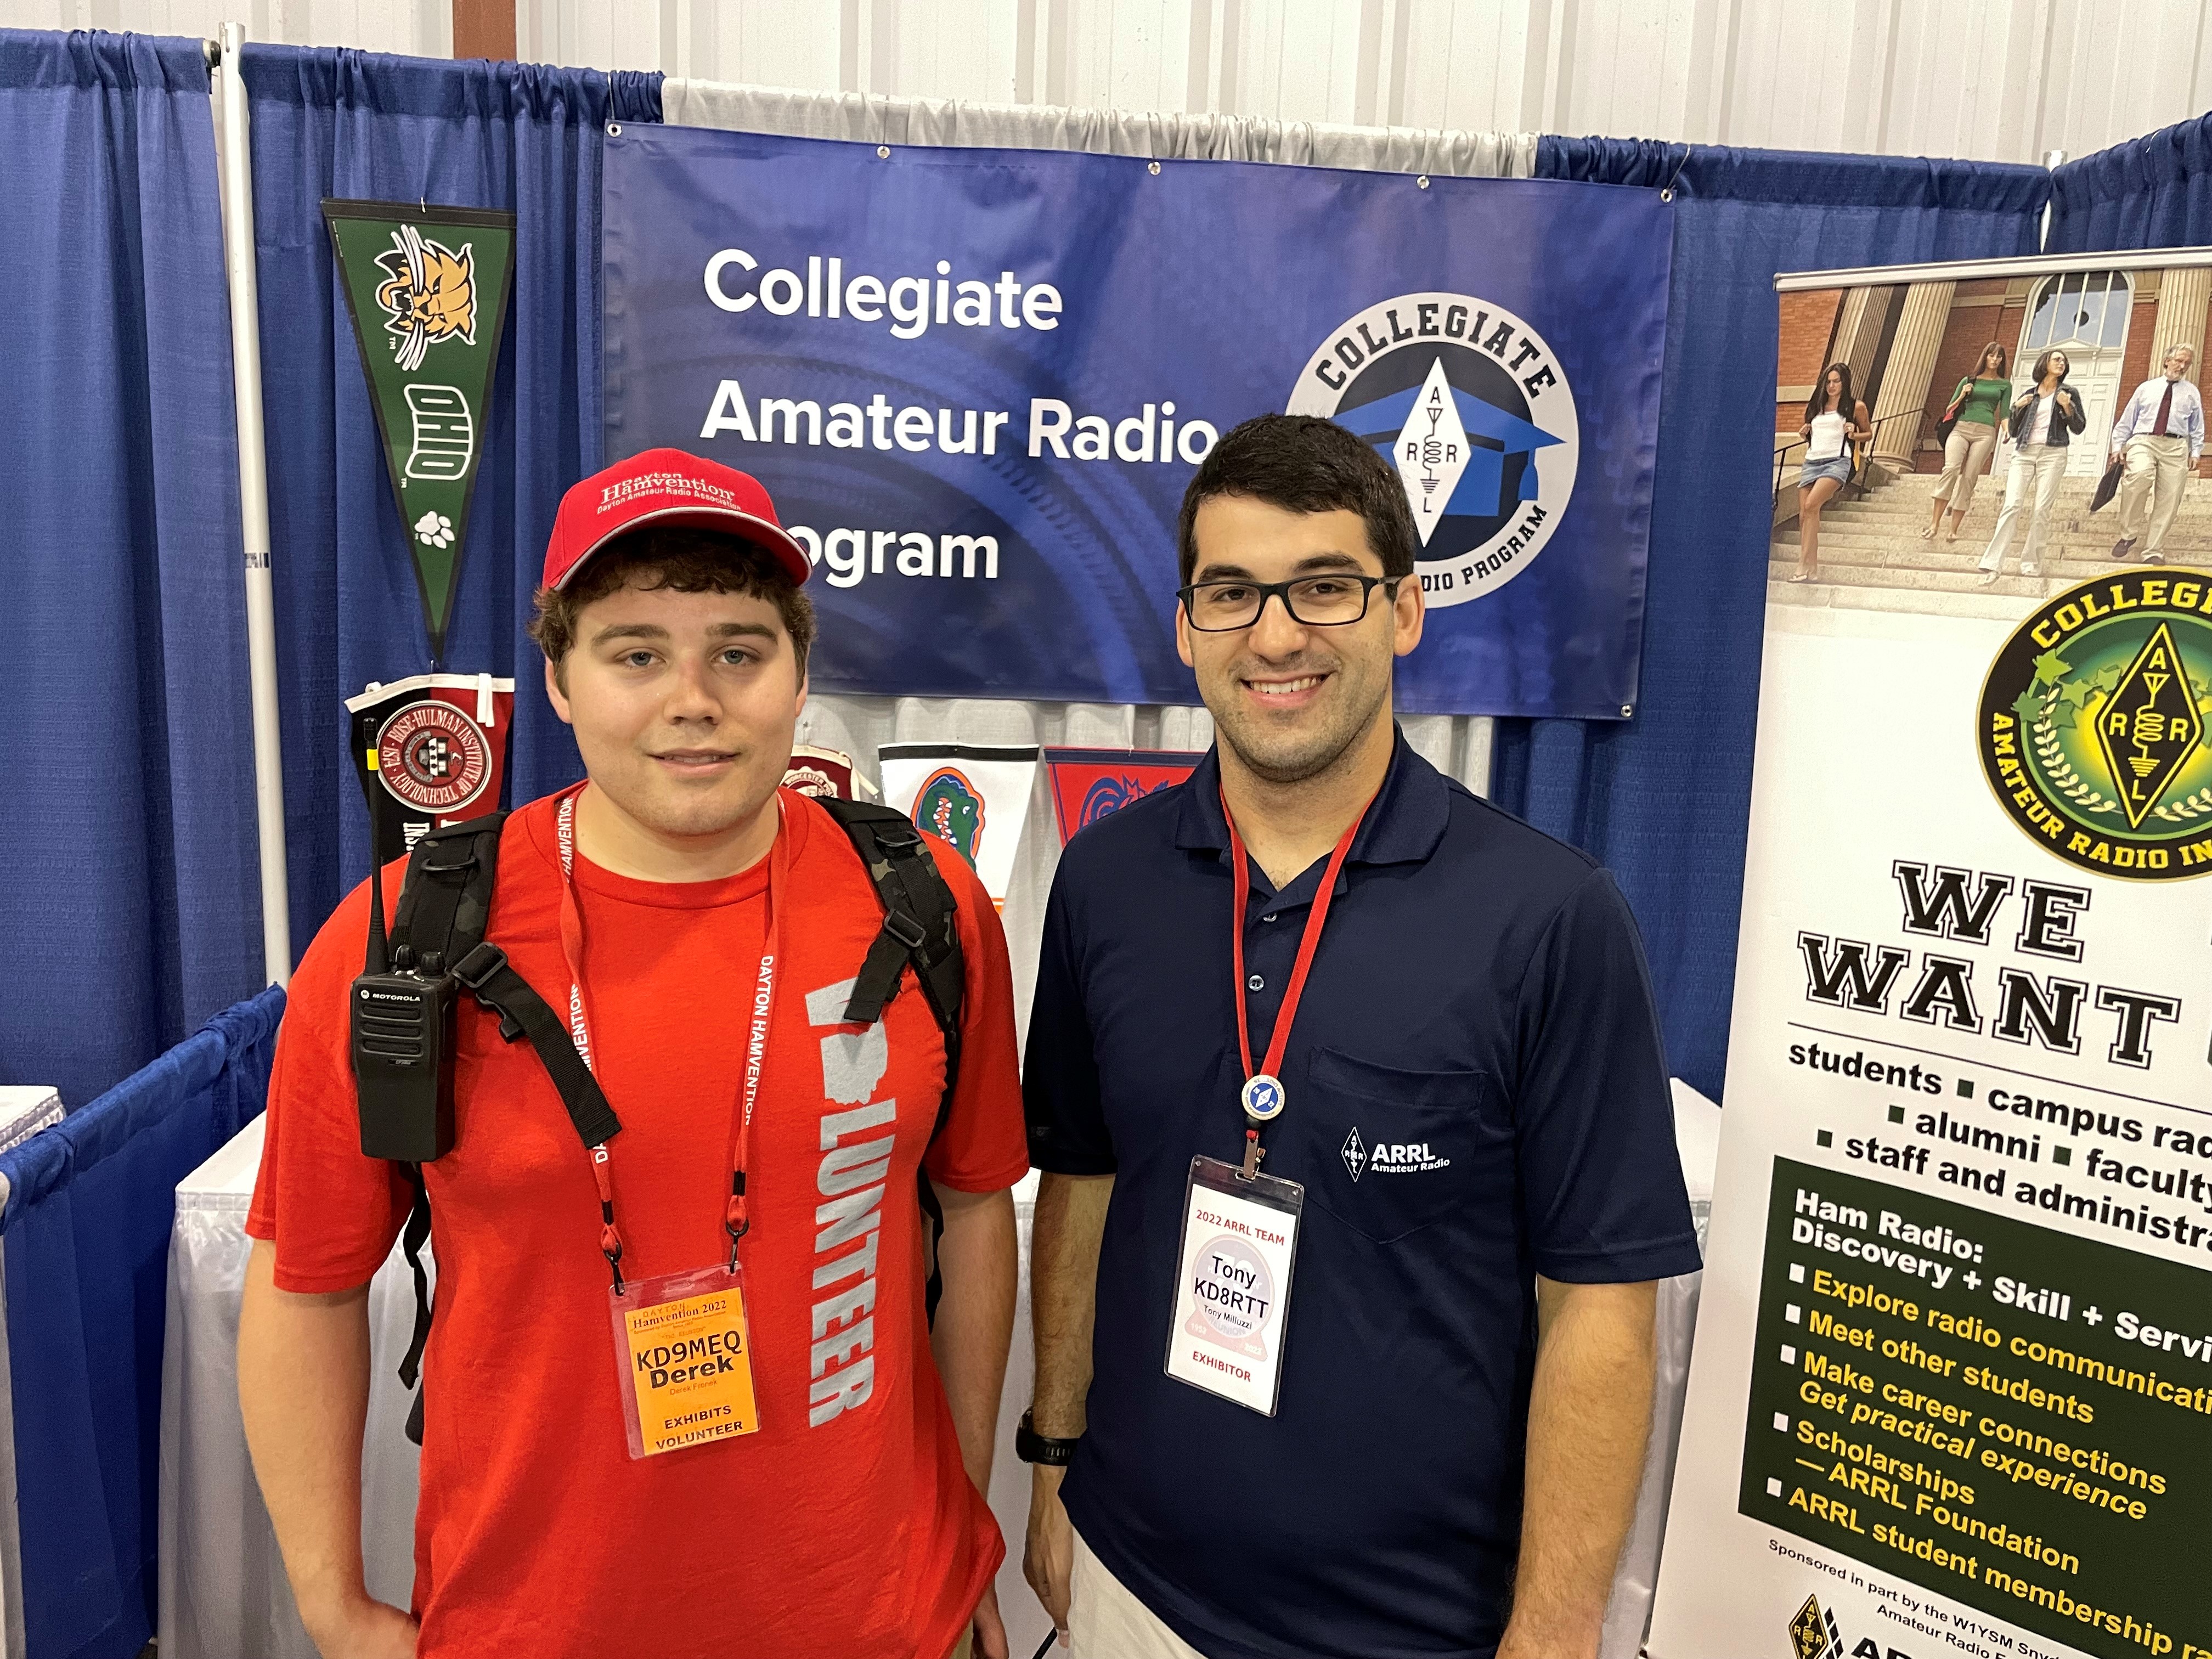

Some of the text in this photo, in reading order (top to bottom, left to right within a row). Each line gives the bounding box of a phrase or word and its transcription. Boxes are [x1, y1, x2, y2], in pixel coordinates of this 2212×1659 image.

[703, 249, 1063, 339] Collegiate
[1315, 303, 1557, 399] COLLEGIATE
[404, 383, 473, 481] OHIO
[700, 380, 1219, 465] Amateur Radio
[597, 487, 741, 514] Dayton Amateur Radio Association
[601, 478, 733, 504] Hamvention
[622, 472, 682, 487] Dayton
[790, 525, 999, 588] ogram
[1422, 504, 1548, 592] DIO PROGRAM
[2031, 579, 2212, 649] COLLEGI
[390, 771, 459, 805] TECHNOLOGY
[456, 777, 473, 797] OF
[458, 726, 483, 783] INSTITUTE
[1993, 712, 2212, 870] AMATEUR RADIO IN
[557, 798, 574, 876] HAMVENTION
[1892, 859, 2092, 963] WE
[569, 986, 592, 1071] VENTION
[1797, 930, 2182, 1070] WANT
[744, 955, 775, 1126] DAYTON HAMVENTION
[1788, 1042, 1943, 1096] students
[1988, 1087, 2143, 1143] campus
[1371, 1143, 1436, 1164] ARRL
[1371, 1158, 1451, 1173] Amateur Radio
[1915, 1110, 2041, 1164] alumni
[1196, 1209, 1285, 1246] 2022 ARRL TEAM
[1796, 1188, 1984, 1263] Ham Radio:
[1846, 1136, 2212, 1254] staff and administr
[1194, 1277, 1269, 1319] KD8RTT
[1212, 1255, 1256, 1290] Tony
[1792, 1217, 1954, 1290] Discovery
[1993, 1277, 2072, 1322] Skill
[2114, 1311, 2212, 1363] Servi
[634, 1308, 699, 1329] Hamvention
[702, 1300, 727, 1313] 2022
[642, 1302, 685, 1318] DAYTON
[1204, 1305, 1252, 1330] Tony Milluzzi
[1813, 1269, 2212, 1415] Explore radio communicati
[636, 1330, 743, 1372] KD9MEQ
[650, 1354, 735, 1390] Derek
[1192, 1350, 1252, 1383] EXHIBITOR
[1809, 1310, 2095, 1425] Meet other students
[664, 1405, 732, 1430] EXHIBITS
[670, 1385, 692, 1396] Derek
[1804, 1350, 2168, 1496] Make career connections
[656, 1421, 743, 1450] VOLUNTEER
[1796, 1420, 1975, 1505] Scholarships
[1799, 1379, 2149, 1521] Get practical experience
[1828, 1462, 1907, 1510] ARRL
[1915, 1498, 2080, 1575] Foundation
[1768, 1539, 1847, 1580] Sponsored
[1851, 1572, 1864, 1588] in
[1868, 1581, 1899, 1602] part
[1901, 1594, 1920, 1612] by
[1924, 1604, 1949, 1622] the
[1953, 1614, 2013, 1650] W1YSM
[1788, 1488, 1865, 1534] ARRL
[1872, 1520, 1978, 1579] student
[1985, 1567, 2173, 1656] membership
[1876, 1604, 1942, 1639] Amateur
[1945, 1631, 1991, 1659] Radio
